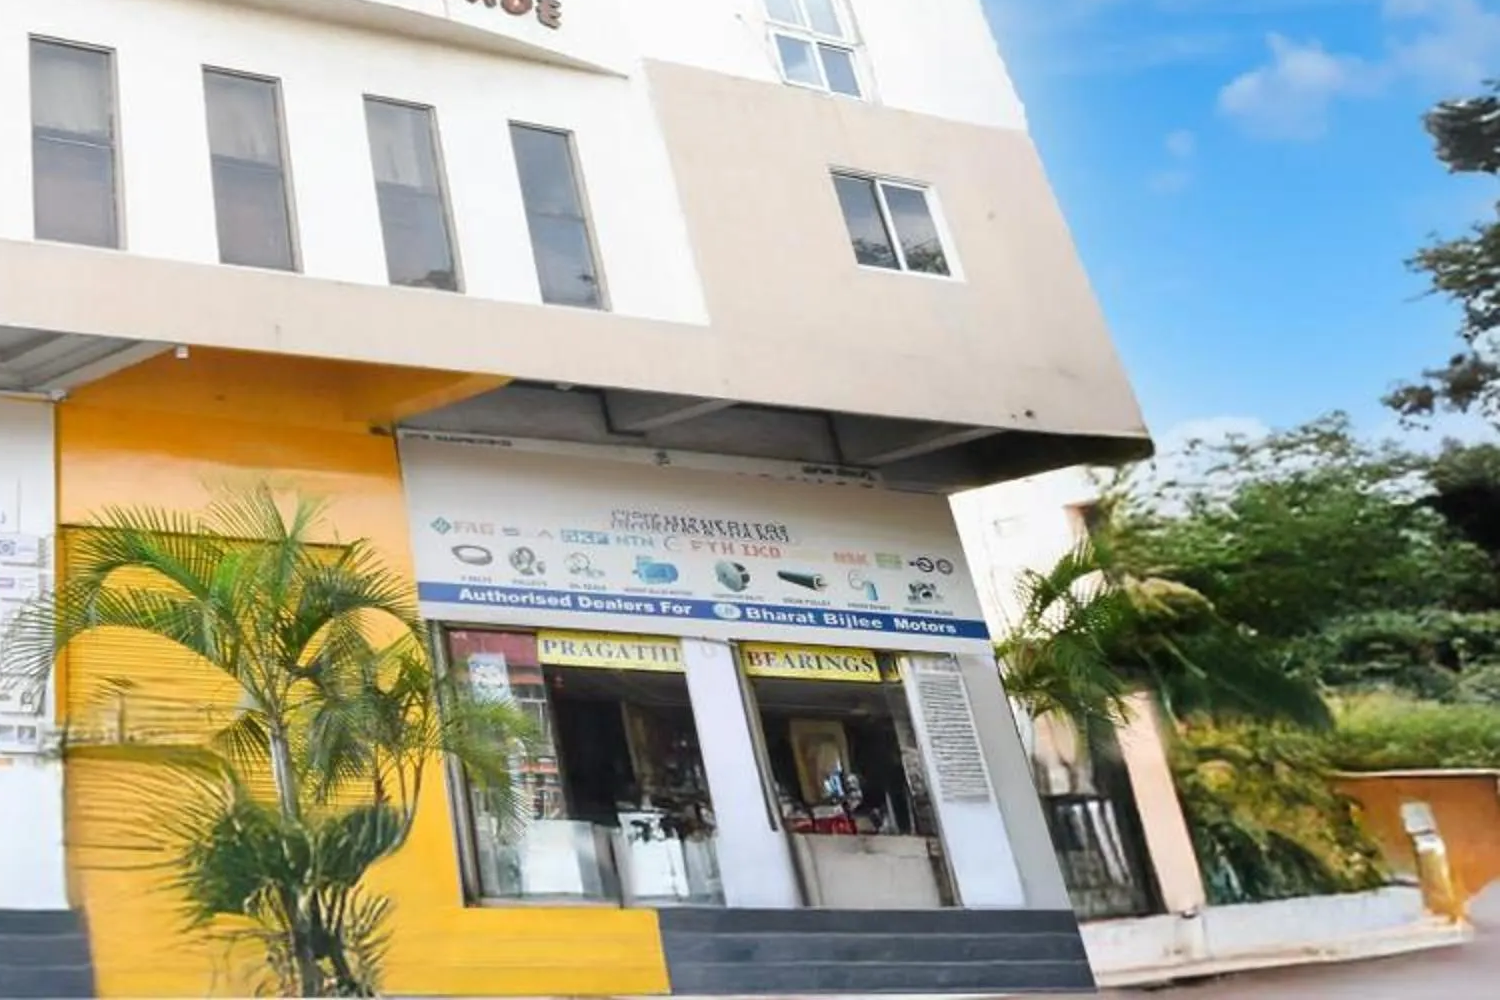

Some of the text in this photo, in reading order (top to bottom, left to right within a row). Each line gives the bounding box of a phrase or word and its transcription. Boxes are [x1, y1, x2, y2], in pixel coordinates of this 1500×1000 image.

[460, 587, 693, 617] Authorised Dealers For
[746, 607, 957, 634] Bharat Bijlee Motors
[749, 650, 875, 674] BEARINGS
